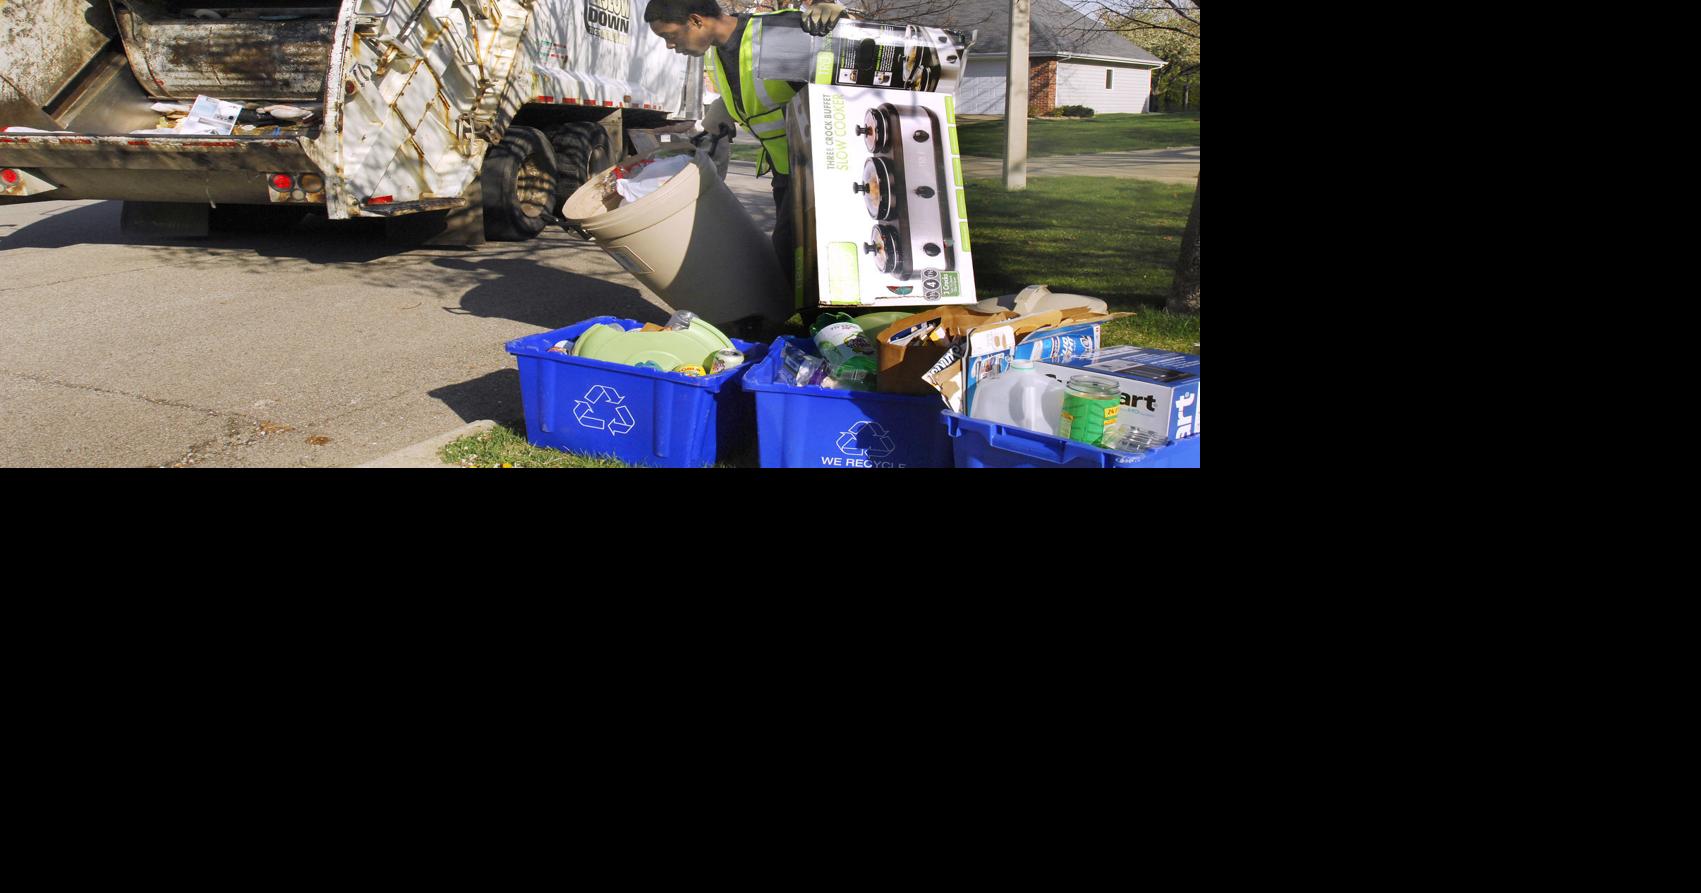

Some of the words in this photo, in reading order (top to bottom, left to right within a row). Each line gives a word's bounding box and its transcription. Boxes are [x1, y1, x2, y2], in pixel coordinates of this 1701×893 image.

[588, 7, 630, 34] DOWN
[822, 93, 832, 119] BUFFET
[832, 94, 847, 138] COOKER
[824, 121, 834, 146] CROCK
[826, 148, 836, 170] THREE
[834, 140, 849, 171] SLOW
[821, 456, 842, 467] WE
